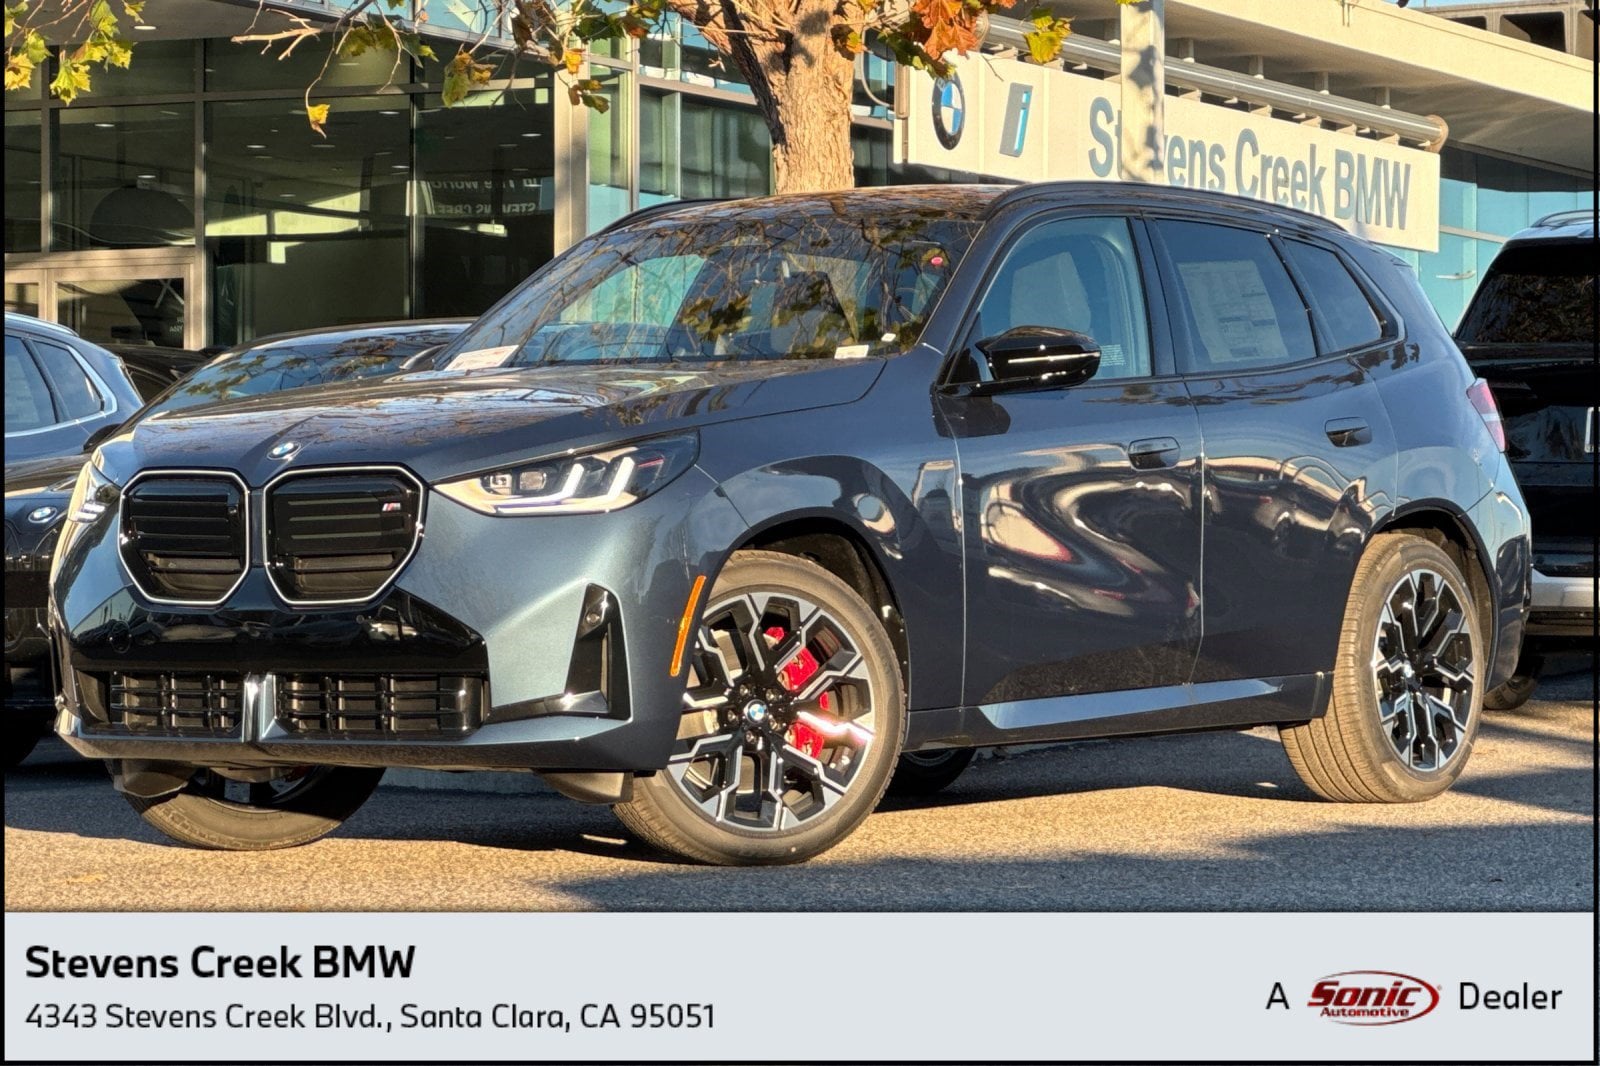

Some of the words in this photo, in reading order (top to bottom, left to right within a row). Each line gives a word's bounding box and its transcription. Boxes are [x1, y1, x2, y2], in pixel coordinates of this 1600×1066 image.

[1088, 96, 1226, 192] Stens
[1235, 128, 1327, 216] Creek
[1334, 149, 1411, 230] BMW
